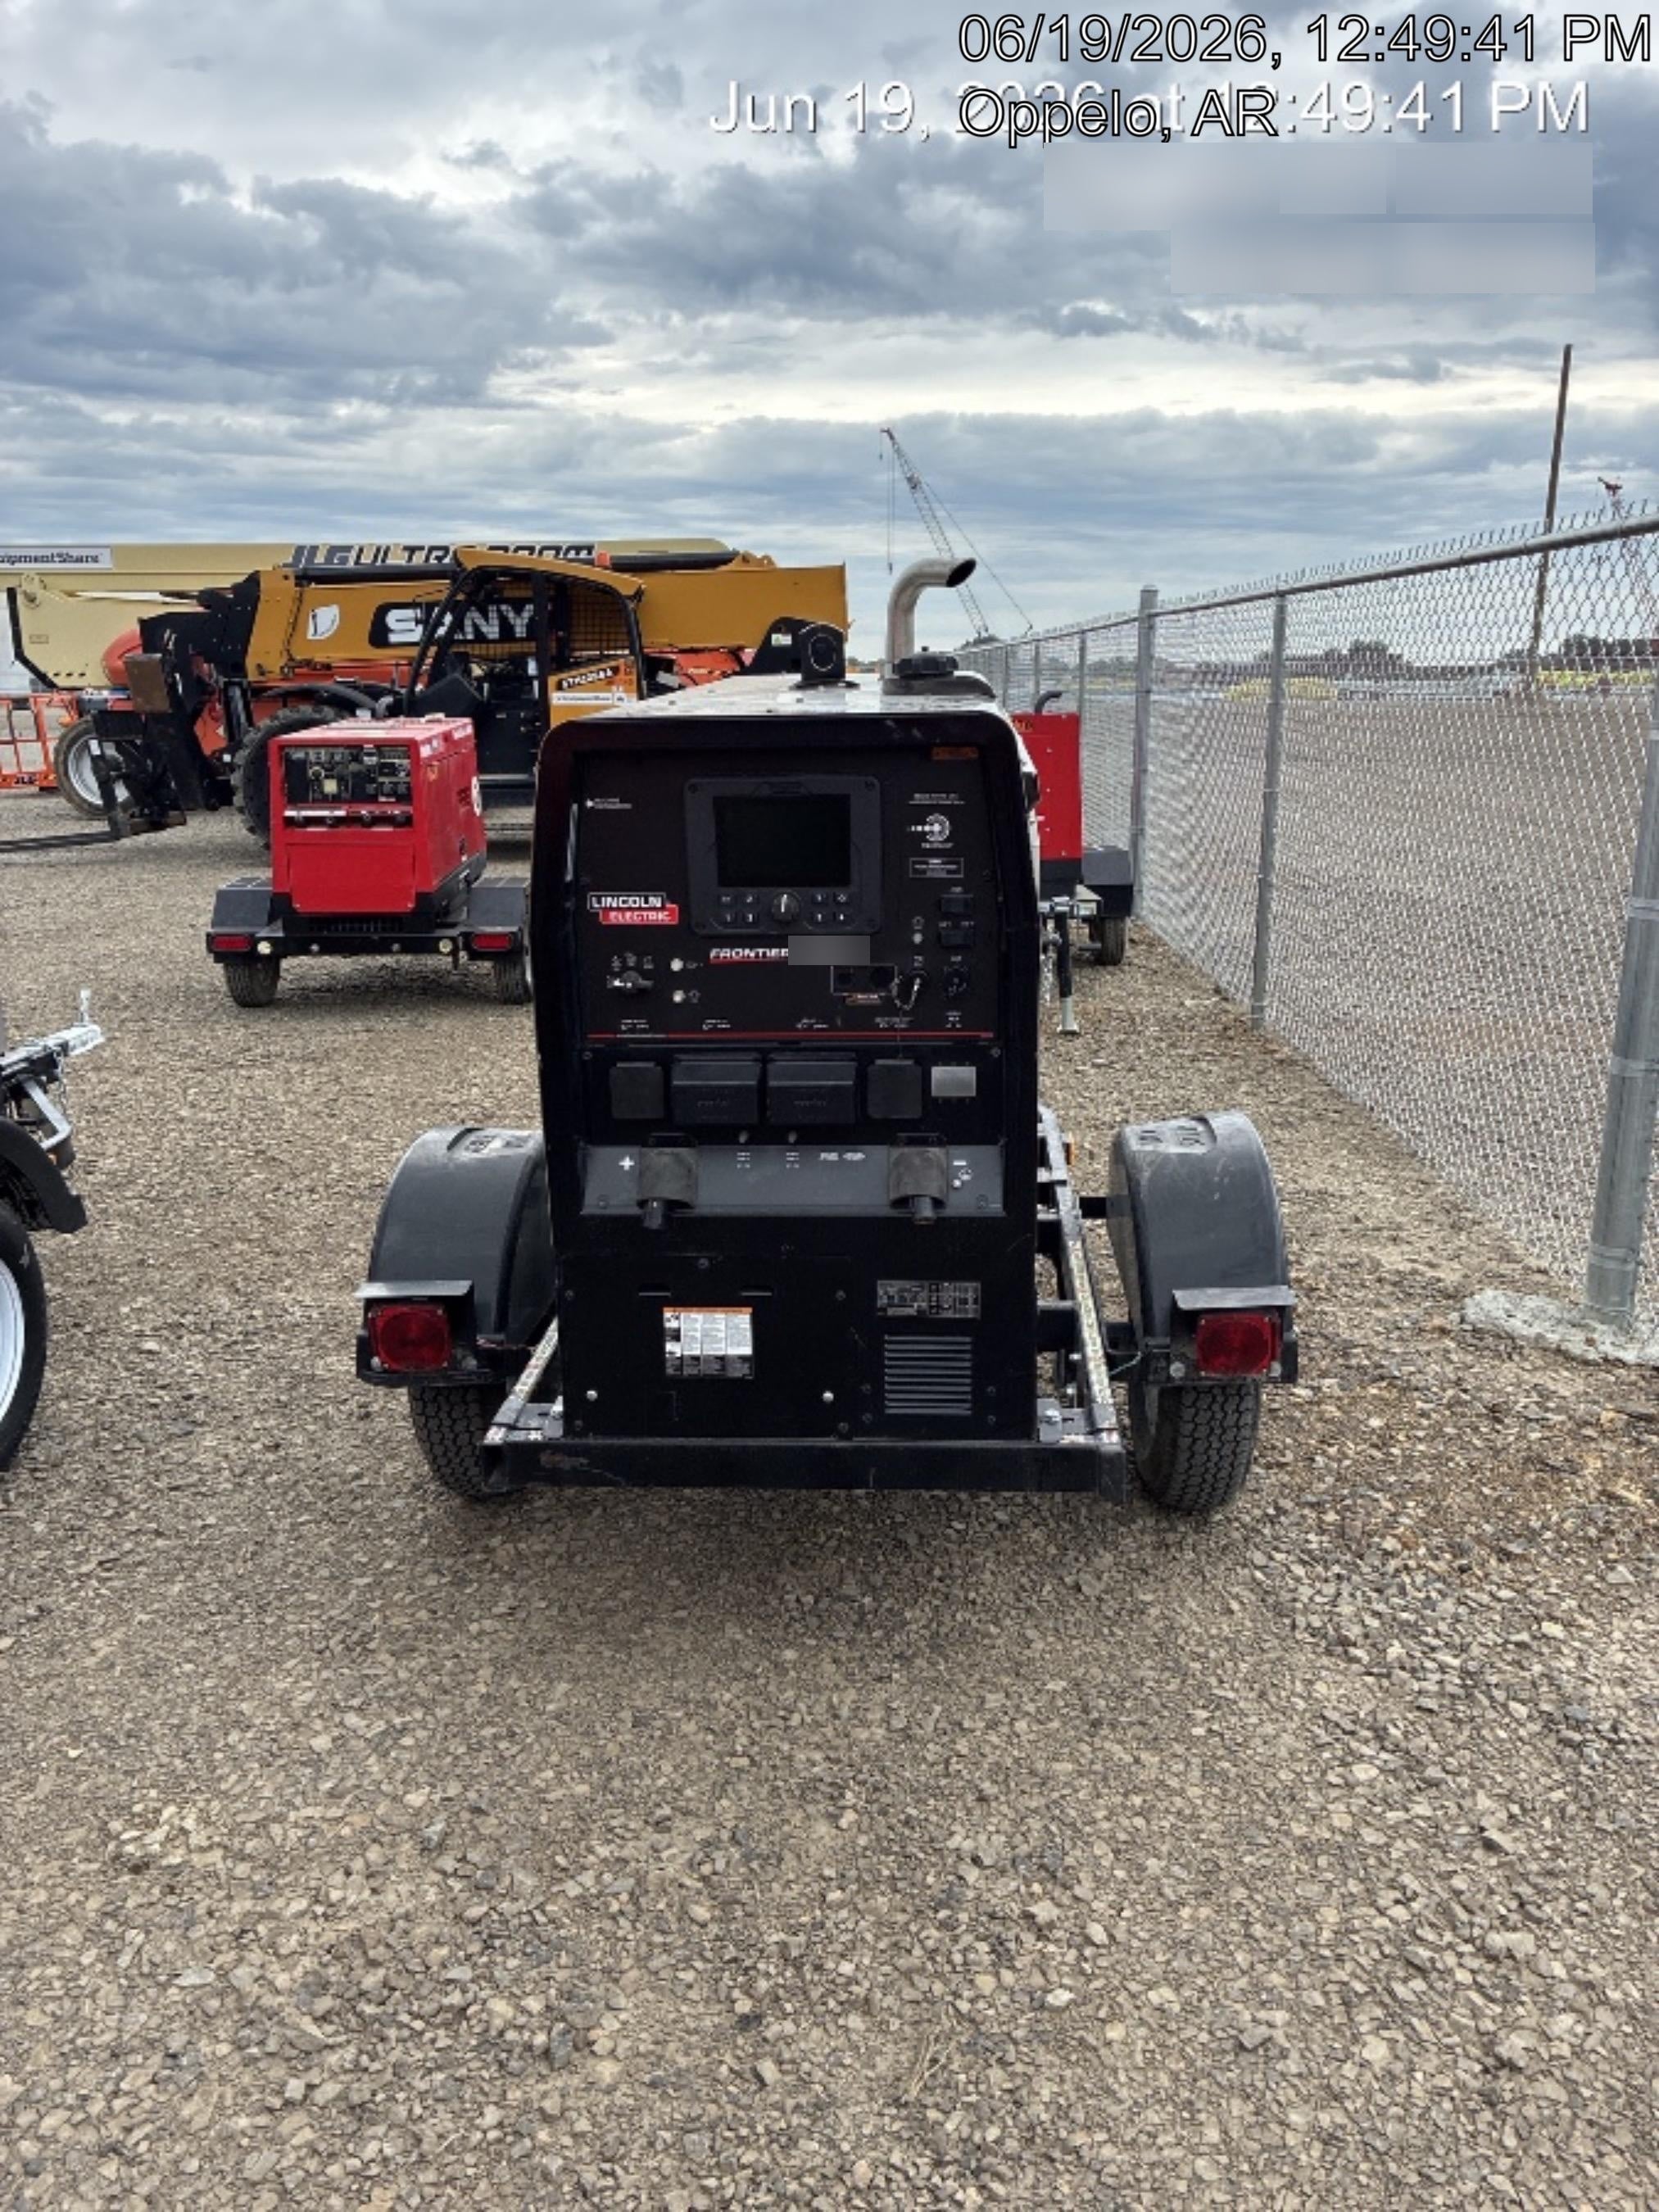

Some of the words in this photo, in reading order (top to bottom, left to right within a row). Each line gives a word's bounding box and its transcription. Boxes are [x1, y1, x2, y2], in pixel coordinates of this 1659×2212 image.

[353, 545, 456, 564] ULTR
[592, 896, 663, 908] LINCOLN
[610, 911, 672, 922] ELECTRIC
